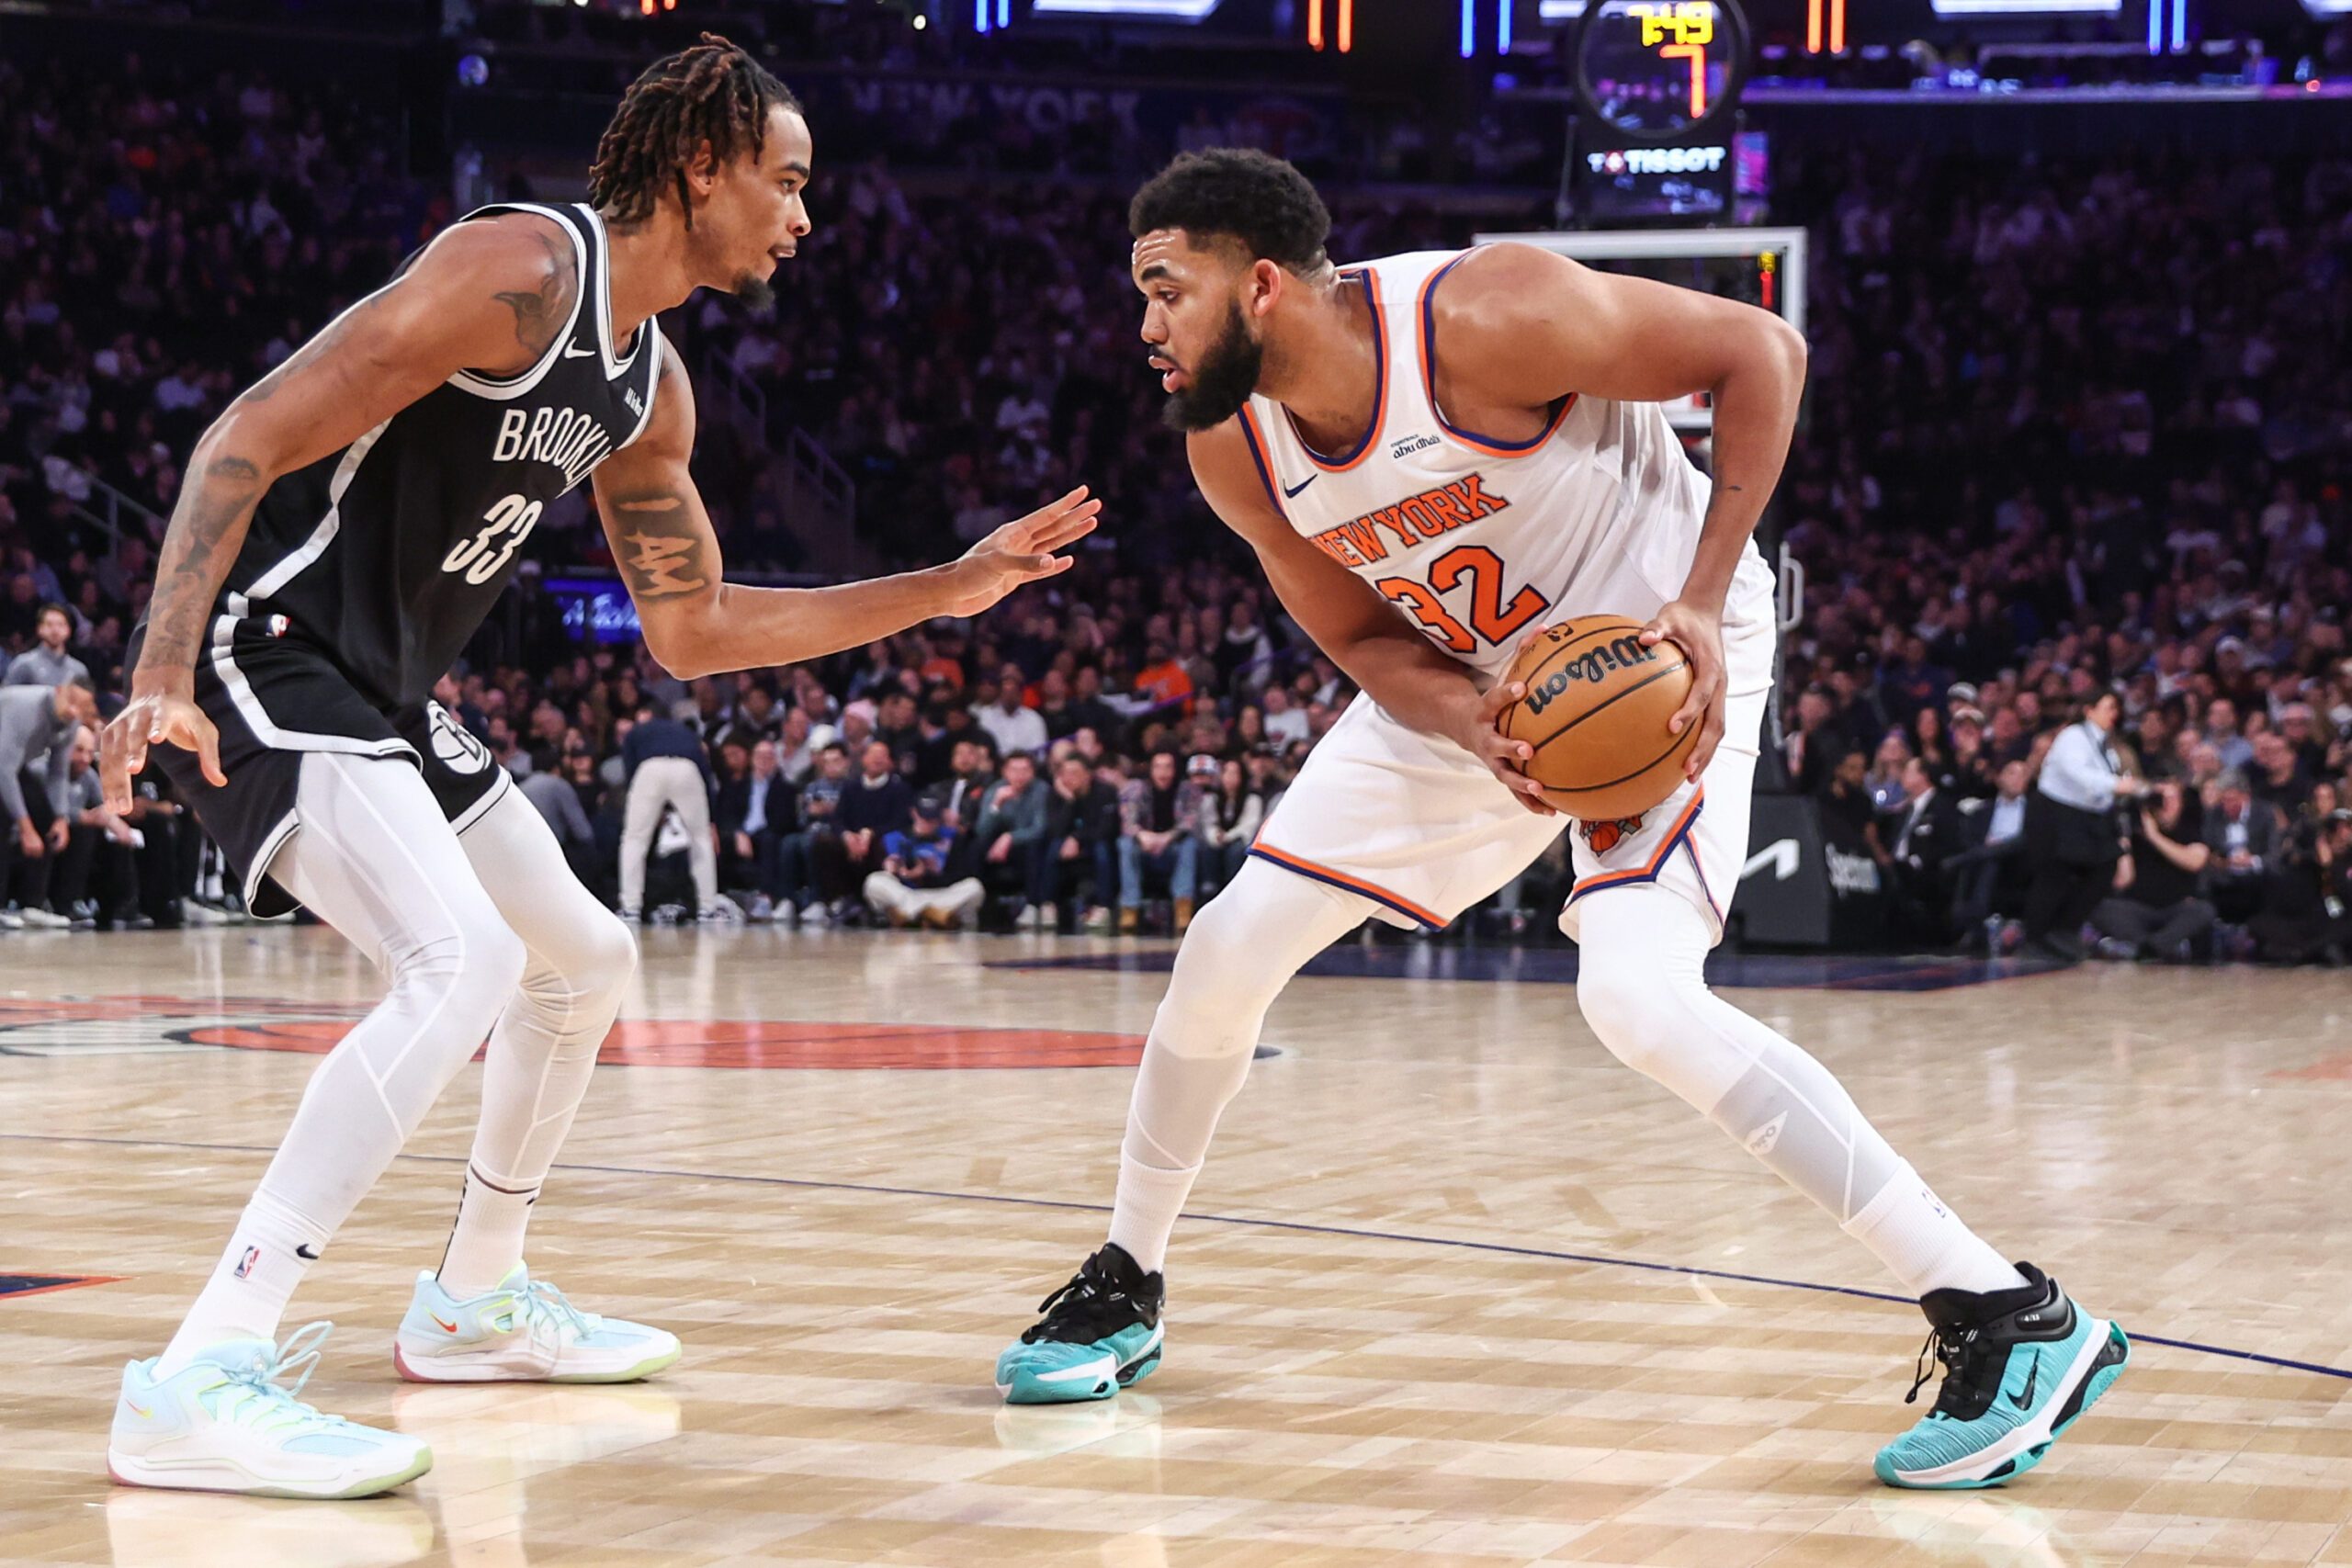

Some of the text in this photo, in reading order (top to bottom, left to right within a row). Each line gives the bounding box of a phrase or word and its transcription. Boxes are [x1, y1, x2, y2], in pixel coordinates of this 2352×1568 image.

[1658, 44, 1706, 118] 7
[1623, 147, 1726, 175] TISSOT
[1394, 444, 1416, 459] abu
[441, 493, 544, 586] 33
[1306, 471, 1512, 568] NEW YORK
[1374, 545, 1552, 654] 32
[1524, 634, 1658, 716] Wilson
